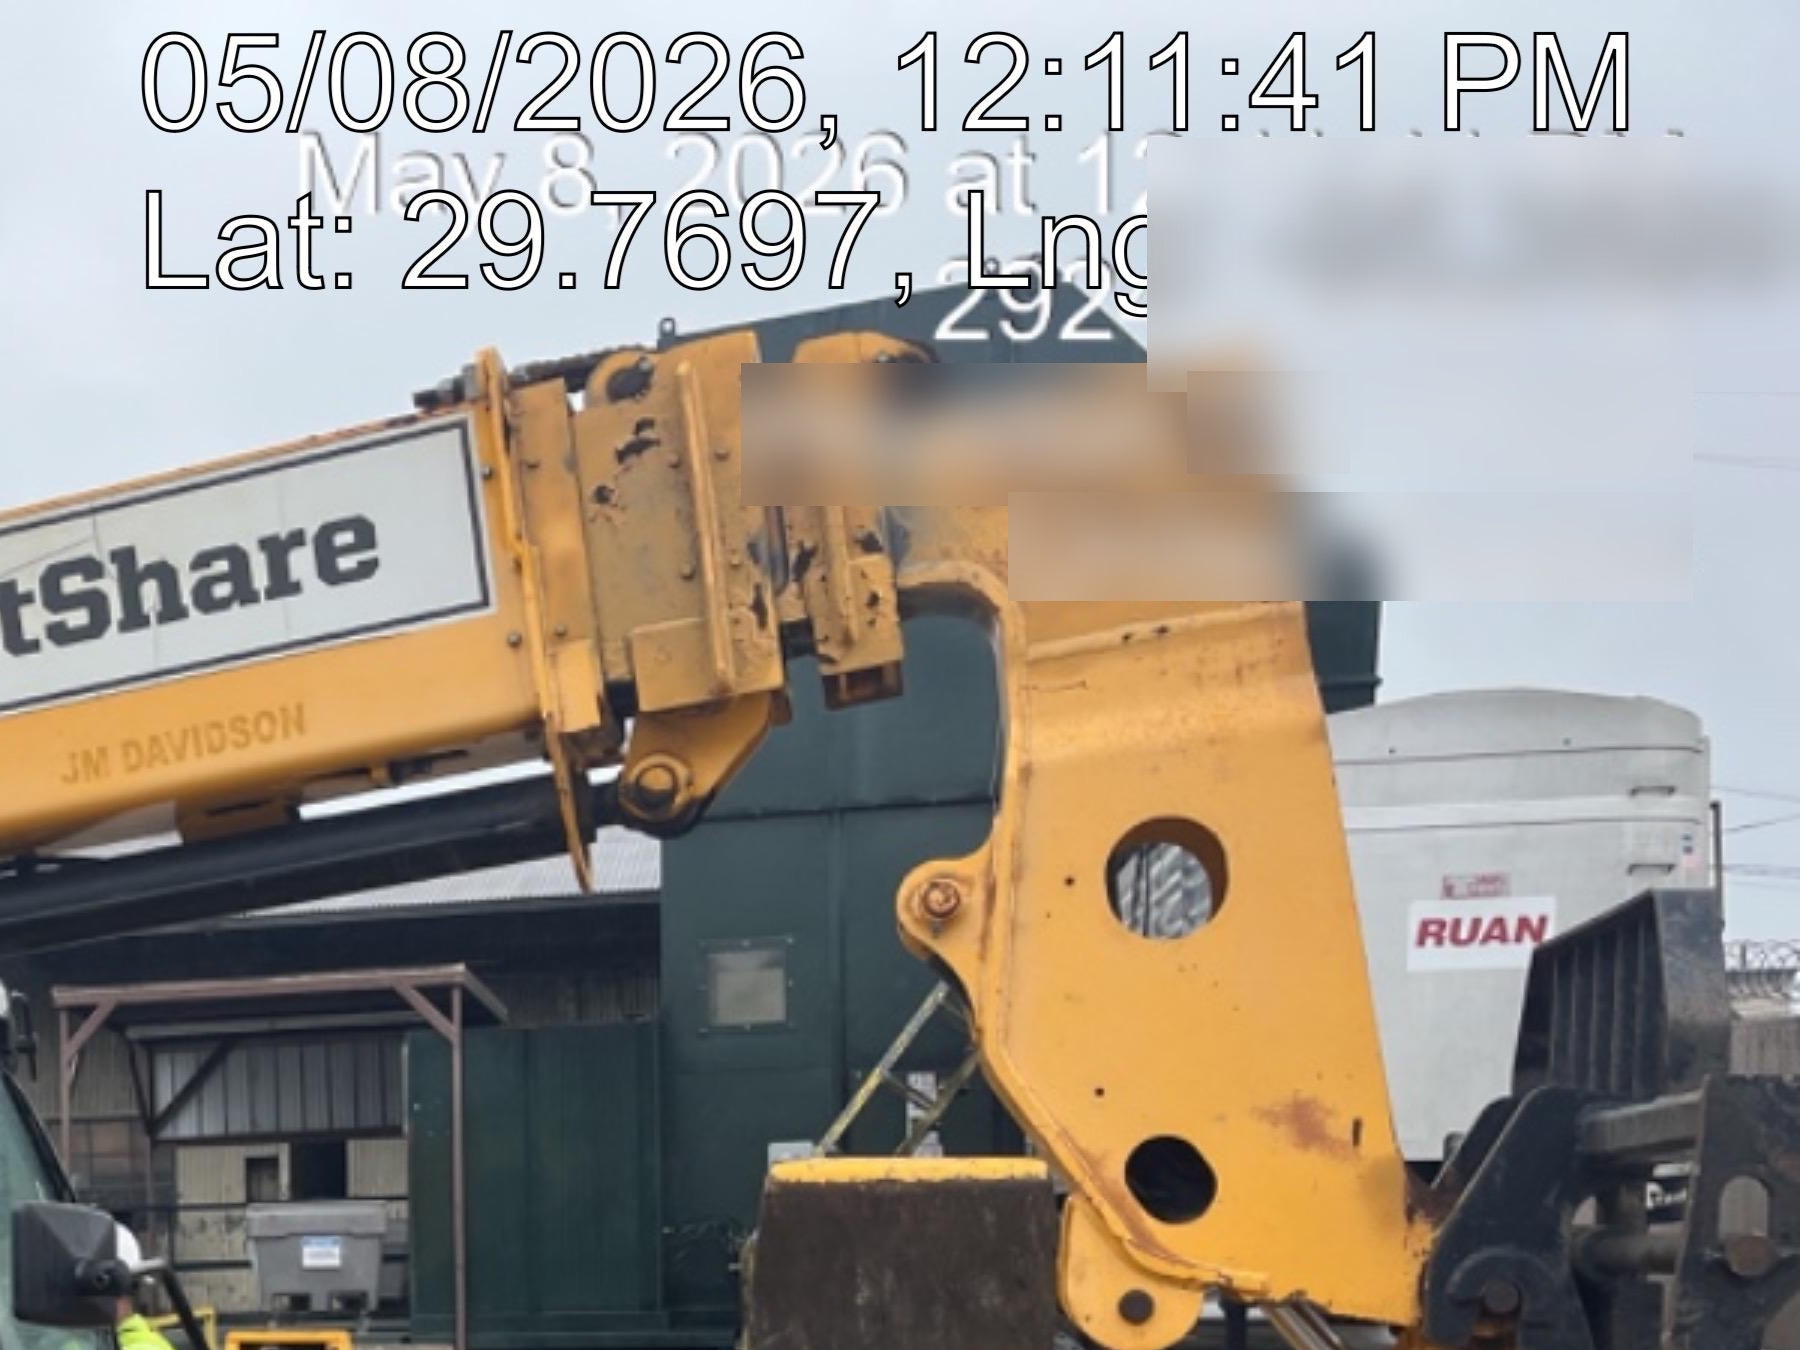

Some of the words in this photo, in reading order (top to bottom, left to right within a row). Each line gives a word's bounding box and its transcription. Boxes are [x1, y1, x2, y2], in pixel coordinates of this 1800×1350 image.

[60, 746, 110, 784] JM
[120, 702, 306, 773] DAVIDSON
[1415, 914, 1548, 948] RUAN
